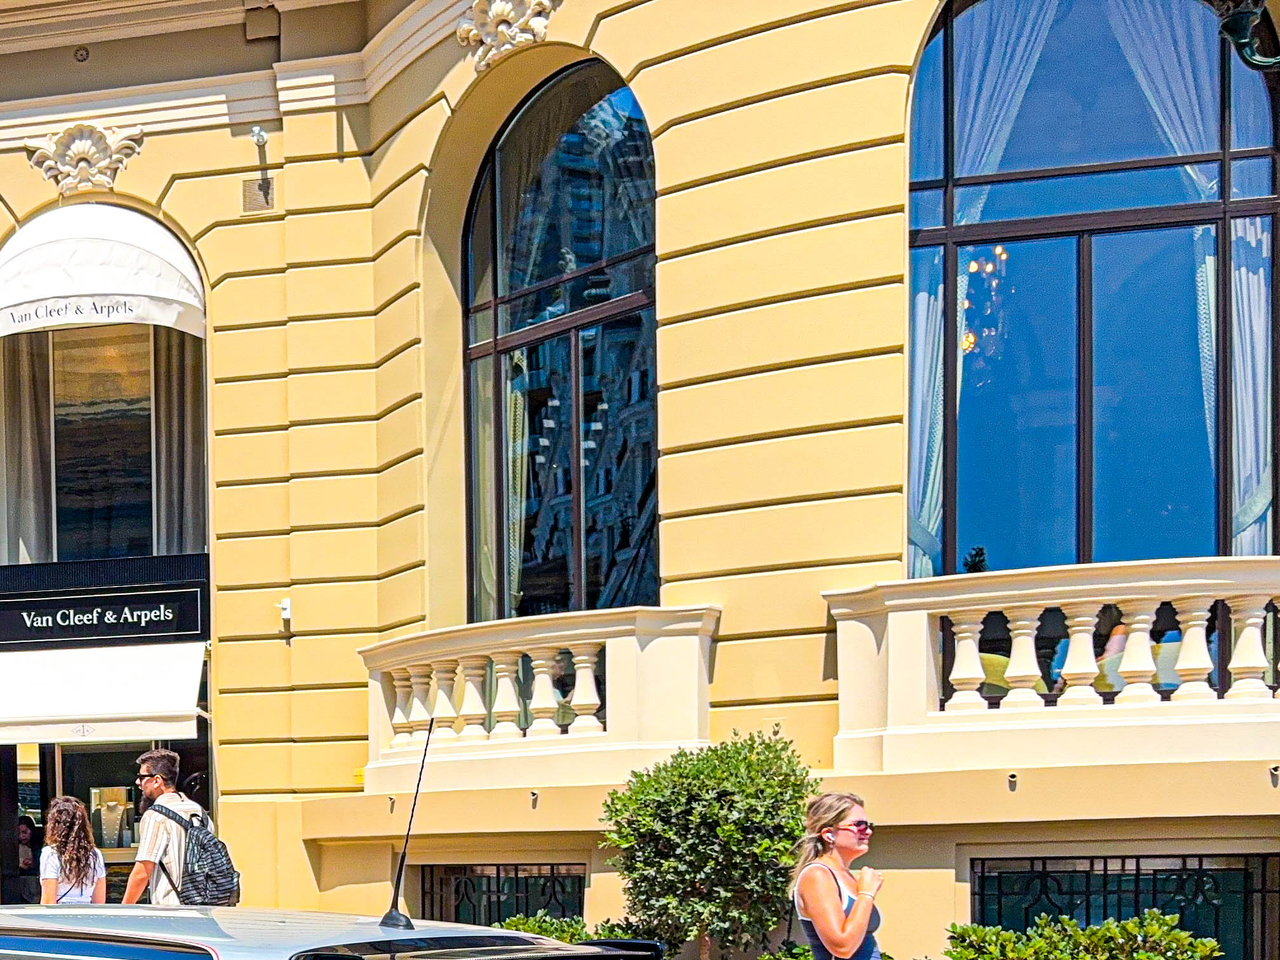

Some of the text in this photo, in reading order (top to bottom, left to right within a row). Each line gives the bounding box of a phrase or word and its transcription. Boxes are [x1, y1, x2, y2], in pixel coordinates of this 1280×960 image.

[10, 301, 134, 324] Van Cleef & Arpels
[21, 604, 174, 628] Van Cleef & Arpels
